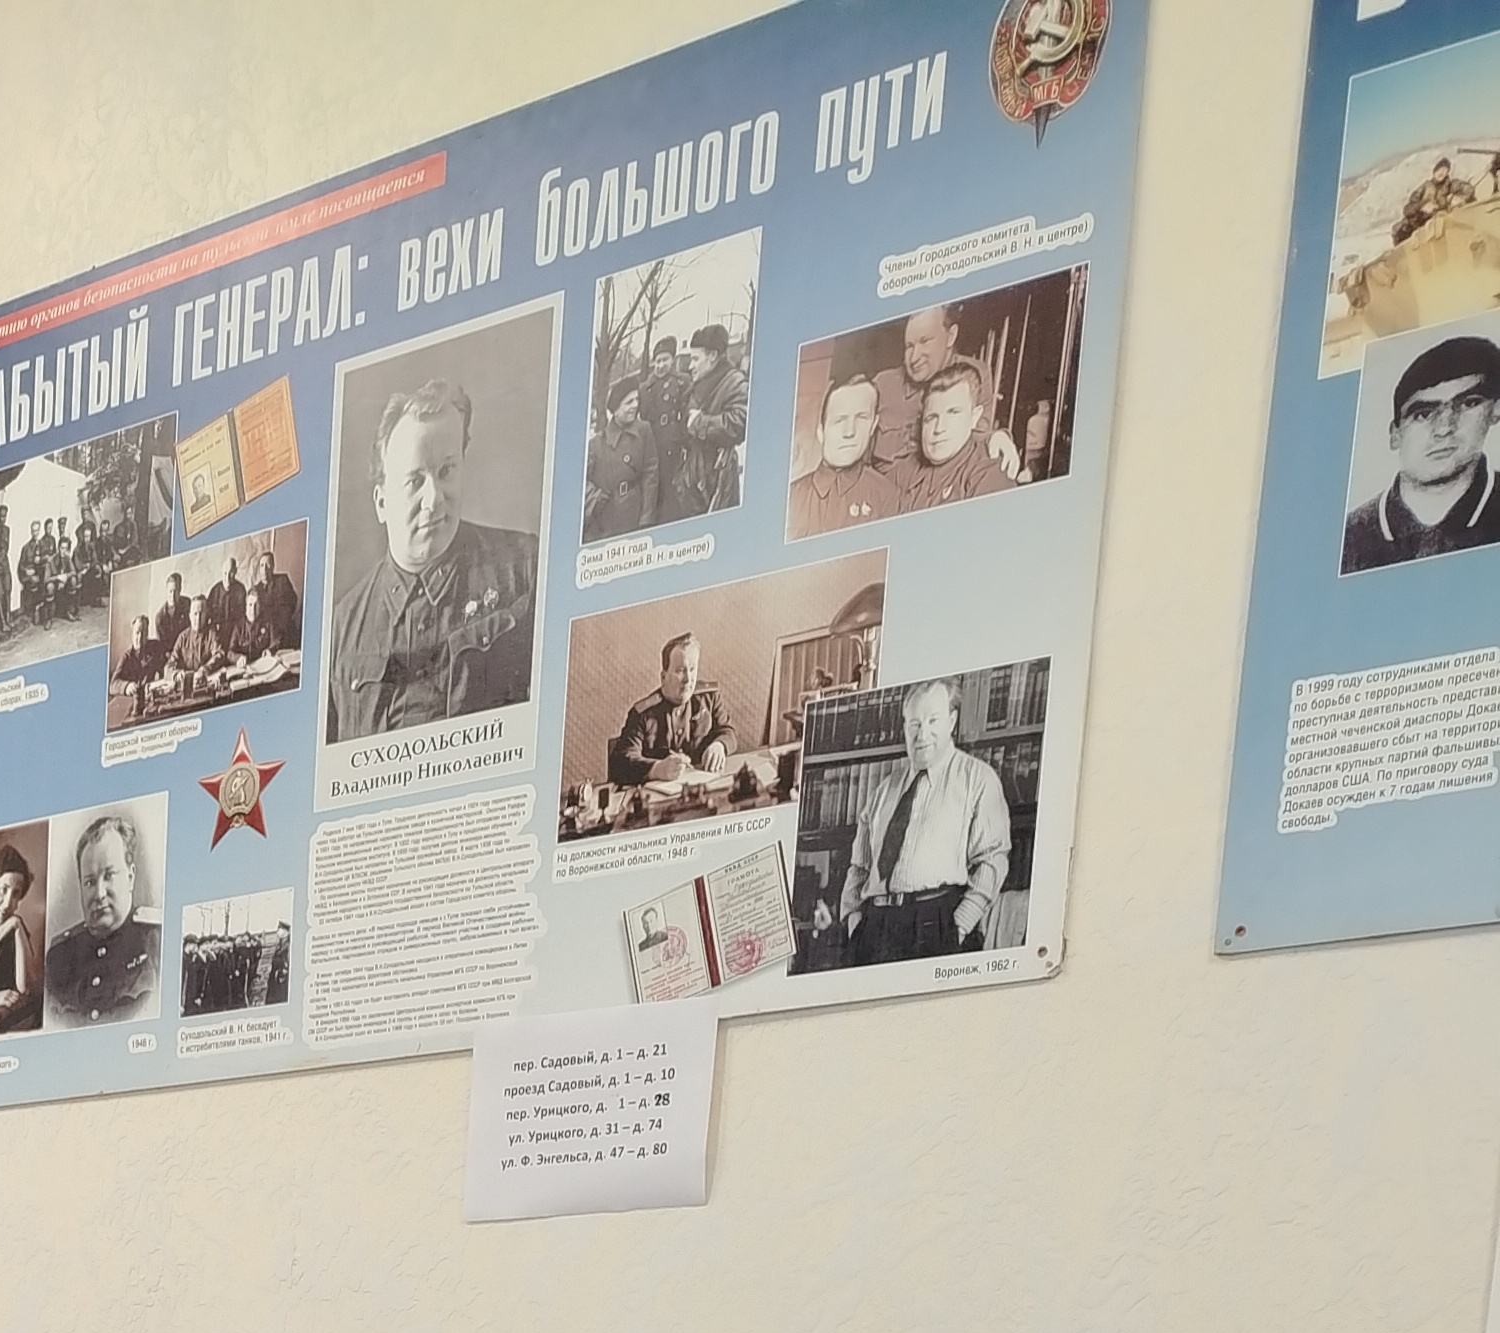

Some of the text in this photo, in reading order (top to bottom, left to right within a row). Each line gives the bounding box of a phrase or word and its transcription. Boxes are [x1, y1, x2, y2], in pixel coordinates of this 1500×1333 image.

[1034, 80, 1059, 100] МГБ
[172, 243, 369, 388] ГЕНЕРАЛ:
[397, 206, 505, 314] вехи
[534, 109, 780, 268] большого
[814, 50, 949, 184] пути
[31, 299, 79, 329] органов
[83, 265, 177, 307] безопасности
[181, 254, 198, 271] на
[319, 169, 425, 218] посвящается
[882, 219, 1089, 291] обороны (Суходольский В. Н. в центре)
[884, 222, 1030, 274] Члены Городского комитета
[580, 540, 710, 582] (Суходольский В. Н. в центре)
[581, 542, 648, 566] Зима 1941 года
[1296, 651, 1496, 696] В 1999 году сотрудниками отдела
[1292, 685, 1500, 730] преступная деятельность представ
[1294, 703, 1307, 713] по
[1311, 694, 1351, 710] борьбе
[1354, 693, 1361, 702] с
[1365, 678, 1444, 701] терроризмом
[105, 722, 199, 750] Городской комитет обороны
[350, 718, 504, 769] СУХОДОЛЬСКИЙ
[1290, 729, 1337, 746] местной
[1340, 720, 1400, 737] чеченской
[1403, 709, 1463, 728] диаспоры
[1287, 763, 1332, 780] области
[1335, 756, 1384, 772] крупных
[1387, 746, 1428, 764] партий
[1289, 740, 1389, 764] организовавшего
[1392, 732, 1421, 746] сбыт
[1424, 729, 1438, 740] на
[330, 747, 524, 798] Владимир Николаевич
[1285, 755, 1489, 798] долларов США. По приговору суда
[1283, 772, 1493, 815] Докаев осужден к 7 годам лишения
[1281, 813, 1333, 829] свободы.
[557, 817, 771, 864] На должности начальника Управления МГБ СССР
[556, 846, 697, 878] по Воронежской области, 1948 г.
[935, 959, 1019, 979] Воронеж, 1962 г.
[513, 1043, 667, 1073] пер. Садовый, д. 1 д. 21
[504, 1068, 675, 1099] проезд Садовый, д. 1 д. 10
[506, 1110, 530, 1122] пер.
[533, 1101, 593, 1120] Урицкого,
[595, 1101, 608, 1114] д.
[619, 1097, 625, 1109] 1
[638, 1097, 651, 1109] д.
[508, 1118, 663, 1147] ул. Урицкого, д. 31 д. 74
[501, 1142, 668, 1171] ул. Ф. Энгельса, д. 47 д. 80
